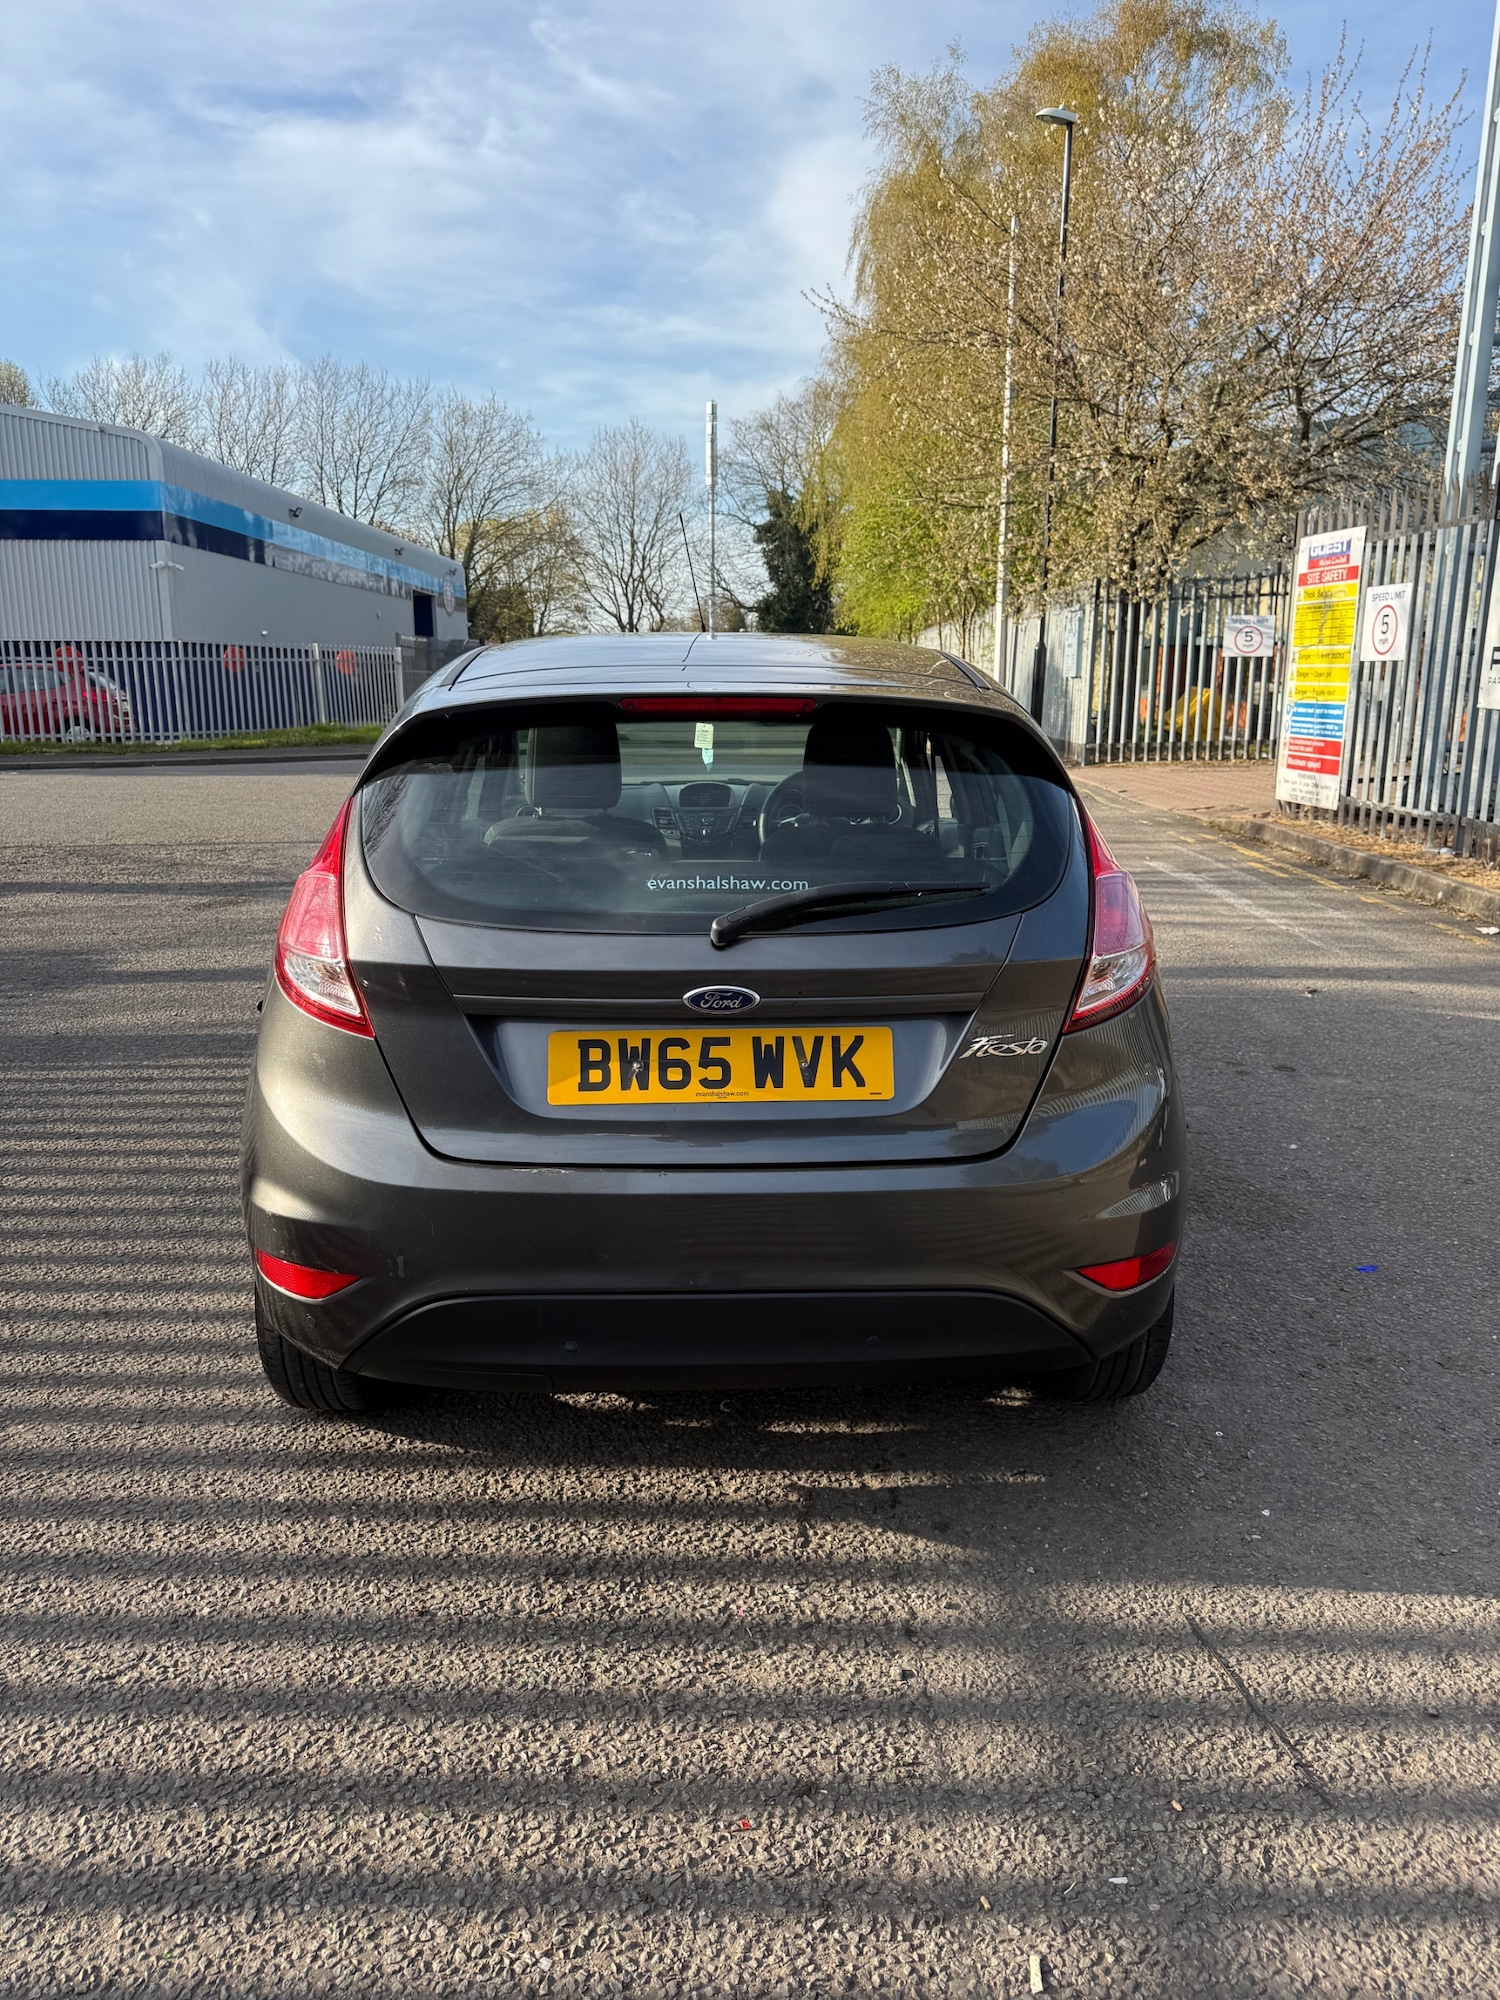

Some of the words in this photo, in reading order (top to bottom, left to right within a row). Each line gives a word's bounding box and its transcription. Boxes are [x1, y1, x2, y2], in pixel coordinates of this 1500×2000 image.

[1310, 539, 1351, 557] GUEST
[1307, 572, 1320, 585] SITE
[1321, 568, 1347, 582] SAFETY
[1372, 592, 1389, 602] SPEED
[1391, 590, 1406, 600] LIMIT
[1381, 614, 1390, 635] 5
[1244, 631, 1253, 643] 5
[647, 875, 809, 890] evanshalshaw.com
[700, 991, 743, 1008] Ford
[958, 1034, 1048, 1059] Fiesta
[578, 1037, 731, 1092] BW65
[752, 1035, 866, 1089] WVK
